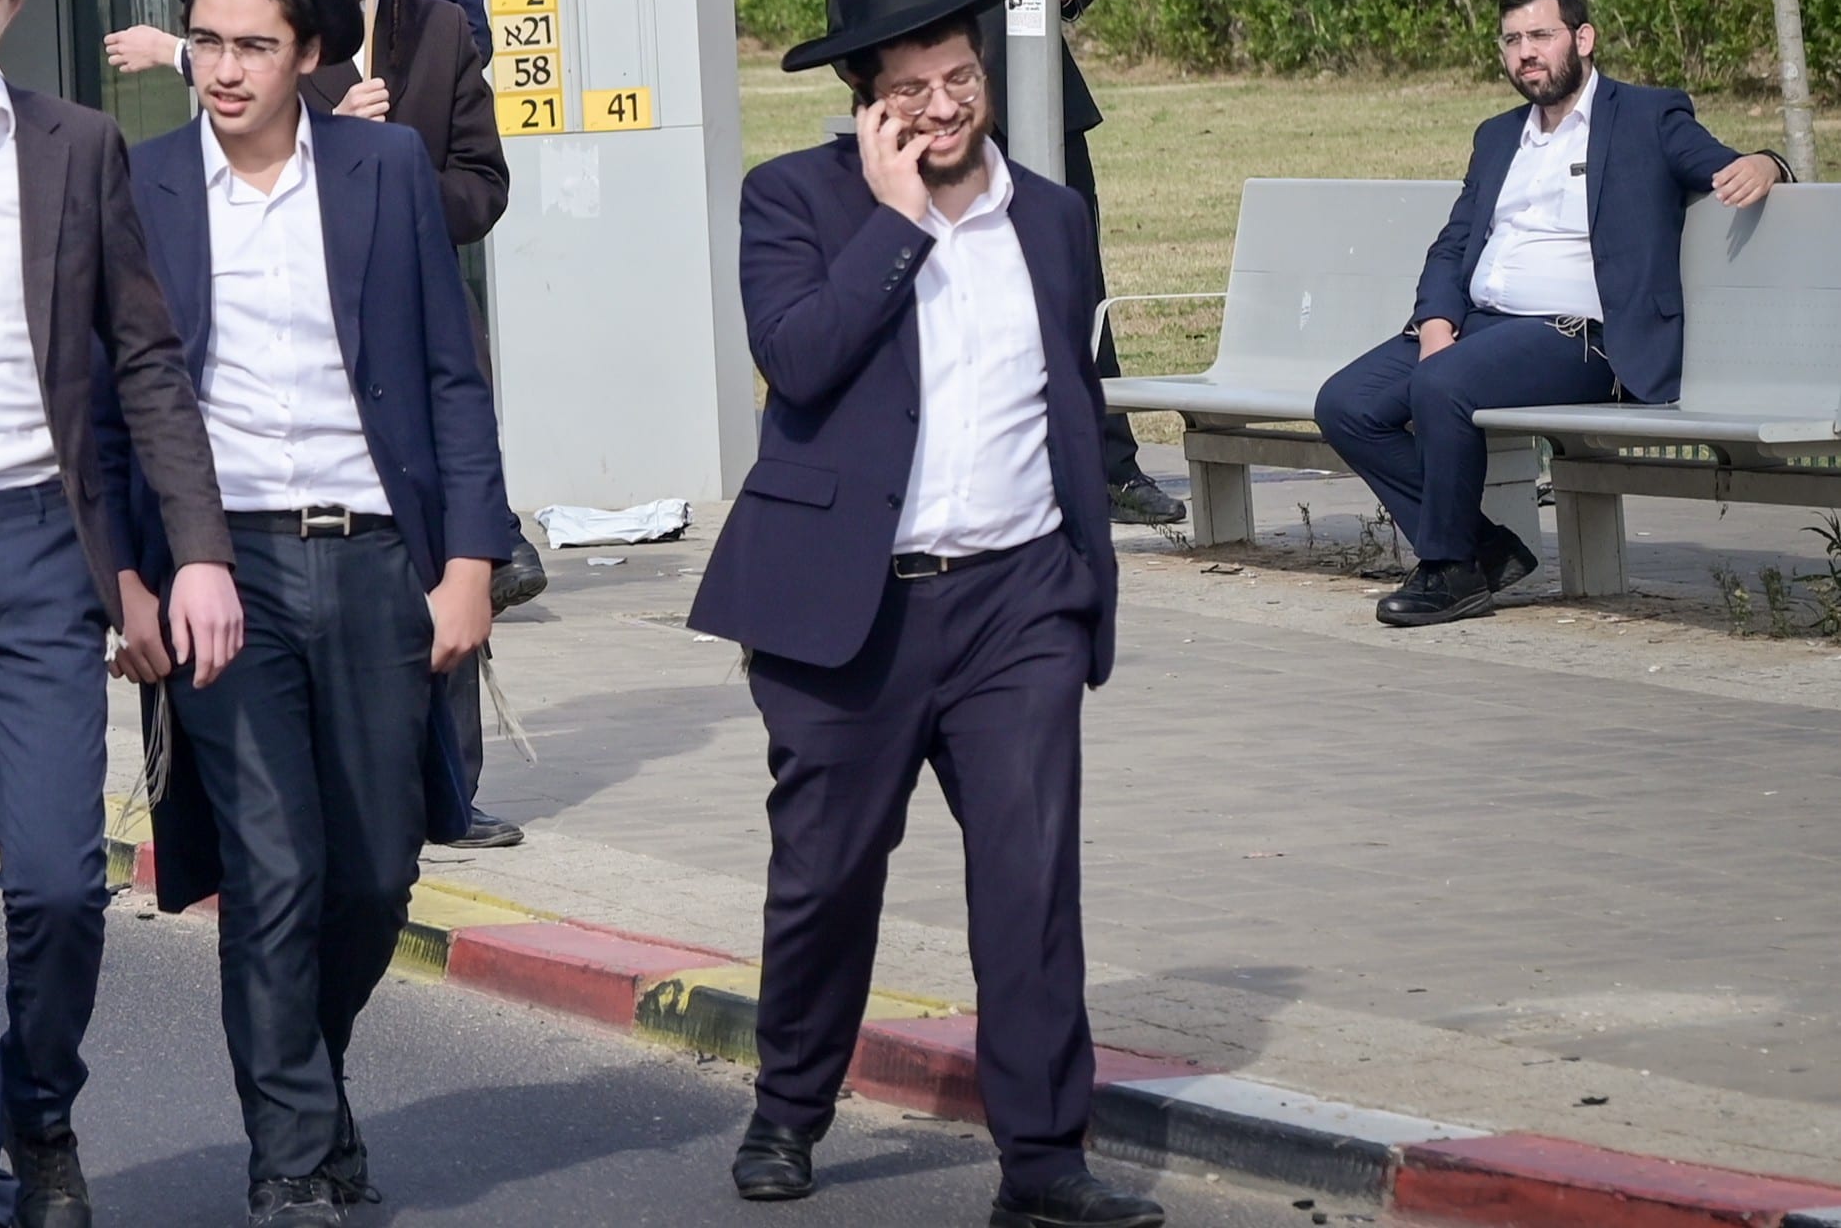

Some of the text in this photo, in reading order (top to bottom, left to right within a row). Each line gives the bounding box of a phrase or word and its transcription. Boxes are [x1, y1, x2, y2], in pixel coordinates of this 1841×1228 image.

[514, 57, 552, 88] 58
[521, 99, 557, 129] 21
[607, 92, 640, 123] 41
